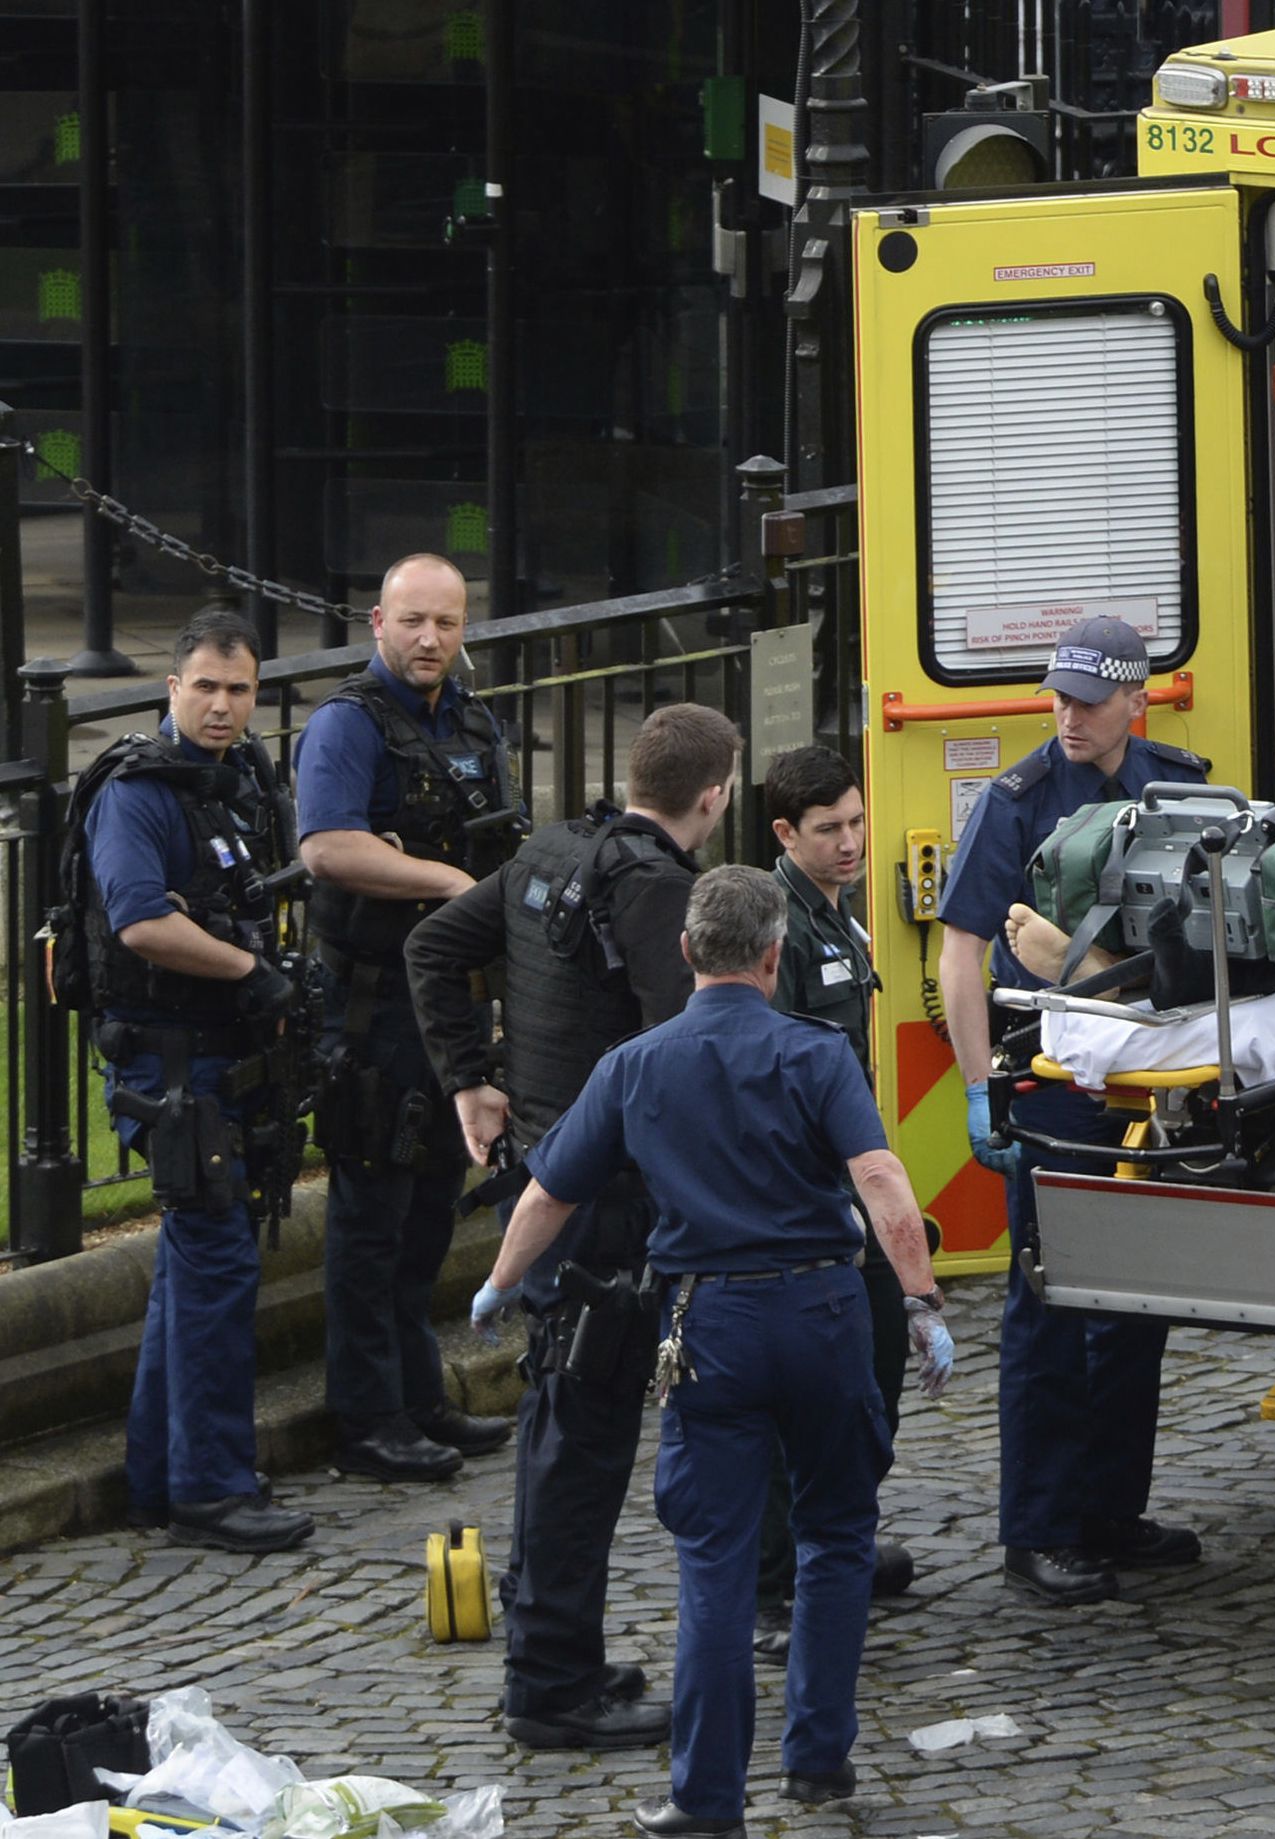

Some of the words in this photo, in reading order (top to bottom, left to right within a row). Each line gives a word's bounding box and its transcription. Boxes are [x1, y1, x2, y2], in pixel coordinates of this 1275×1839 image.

[1149, 124, 1213, 153] 8132
[996, 266, 1066, 279] EMERGENCY
[1068, 265, 1092, 275] EXIT
[1003, 621, 1027, 631] HOLD
[1028, 619, 1054, 629] HAND
[971, 635, 989, 644] RISK
[991, 634, 1001, 643] OF
[1005, 632, 1031, 642] PINCH
[1033, 630, 1057, 640] POINT
